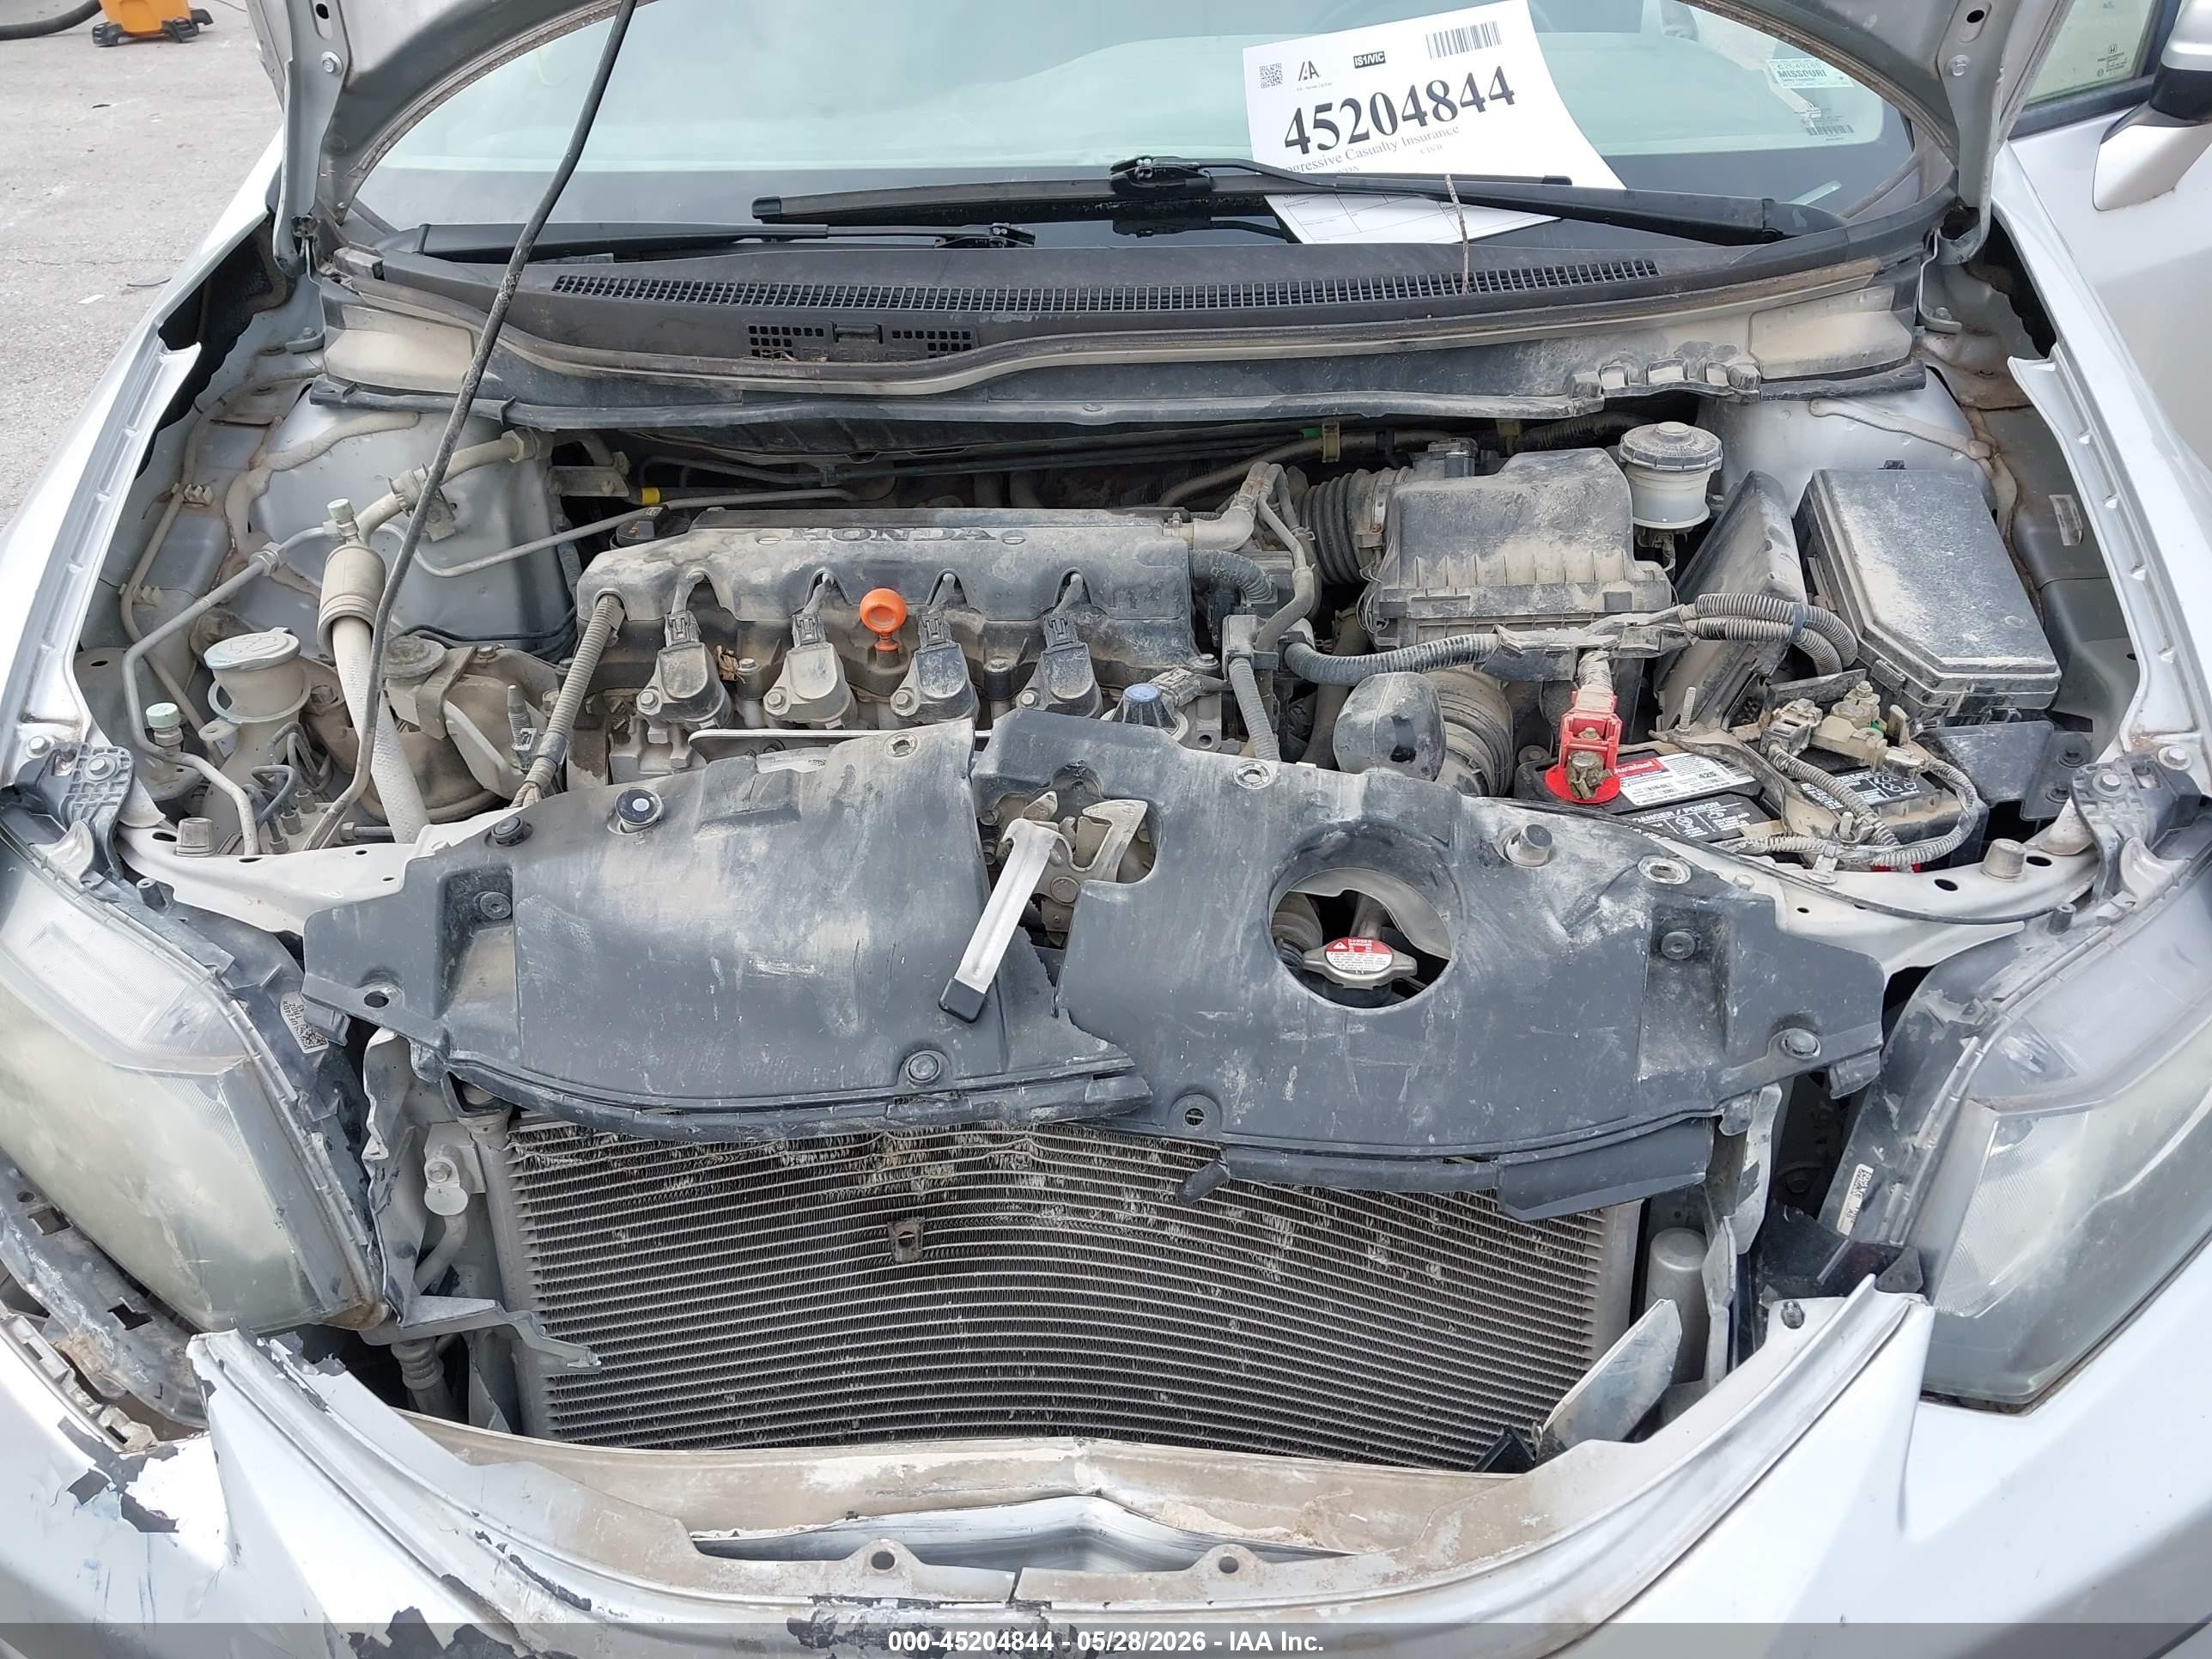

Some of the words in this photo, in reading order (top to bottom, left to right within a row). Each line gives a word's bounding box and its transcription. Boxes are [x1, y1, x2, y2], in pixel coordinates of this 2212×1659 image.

[1778, 70, 1827, 78] MISSOURI
[1285, 65, 1515, 155] 45204844
[1285, 154, 1343, 173] ogressive
[1345, 138, 1398, 161] Casualty
[1401, 125, 1461, 148] Insurance
[785, 526, 997, 543] HONDA
[1684, 801, 1721, 814] POISON
